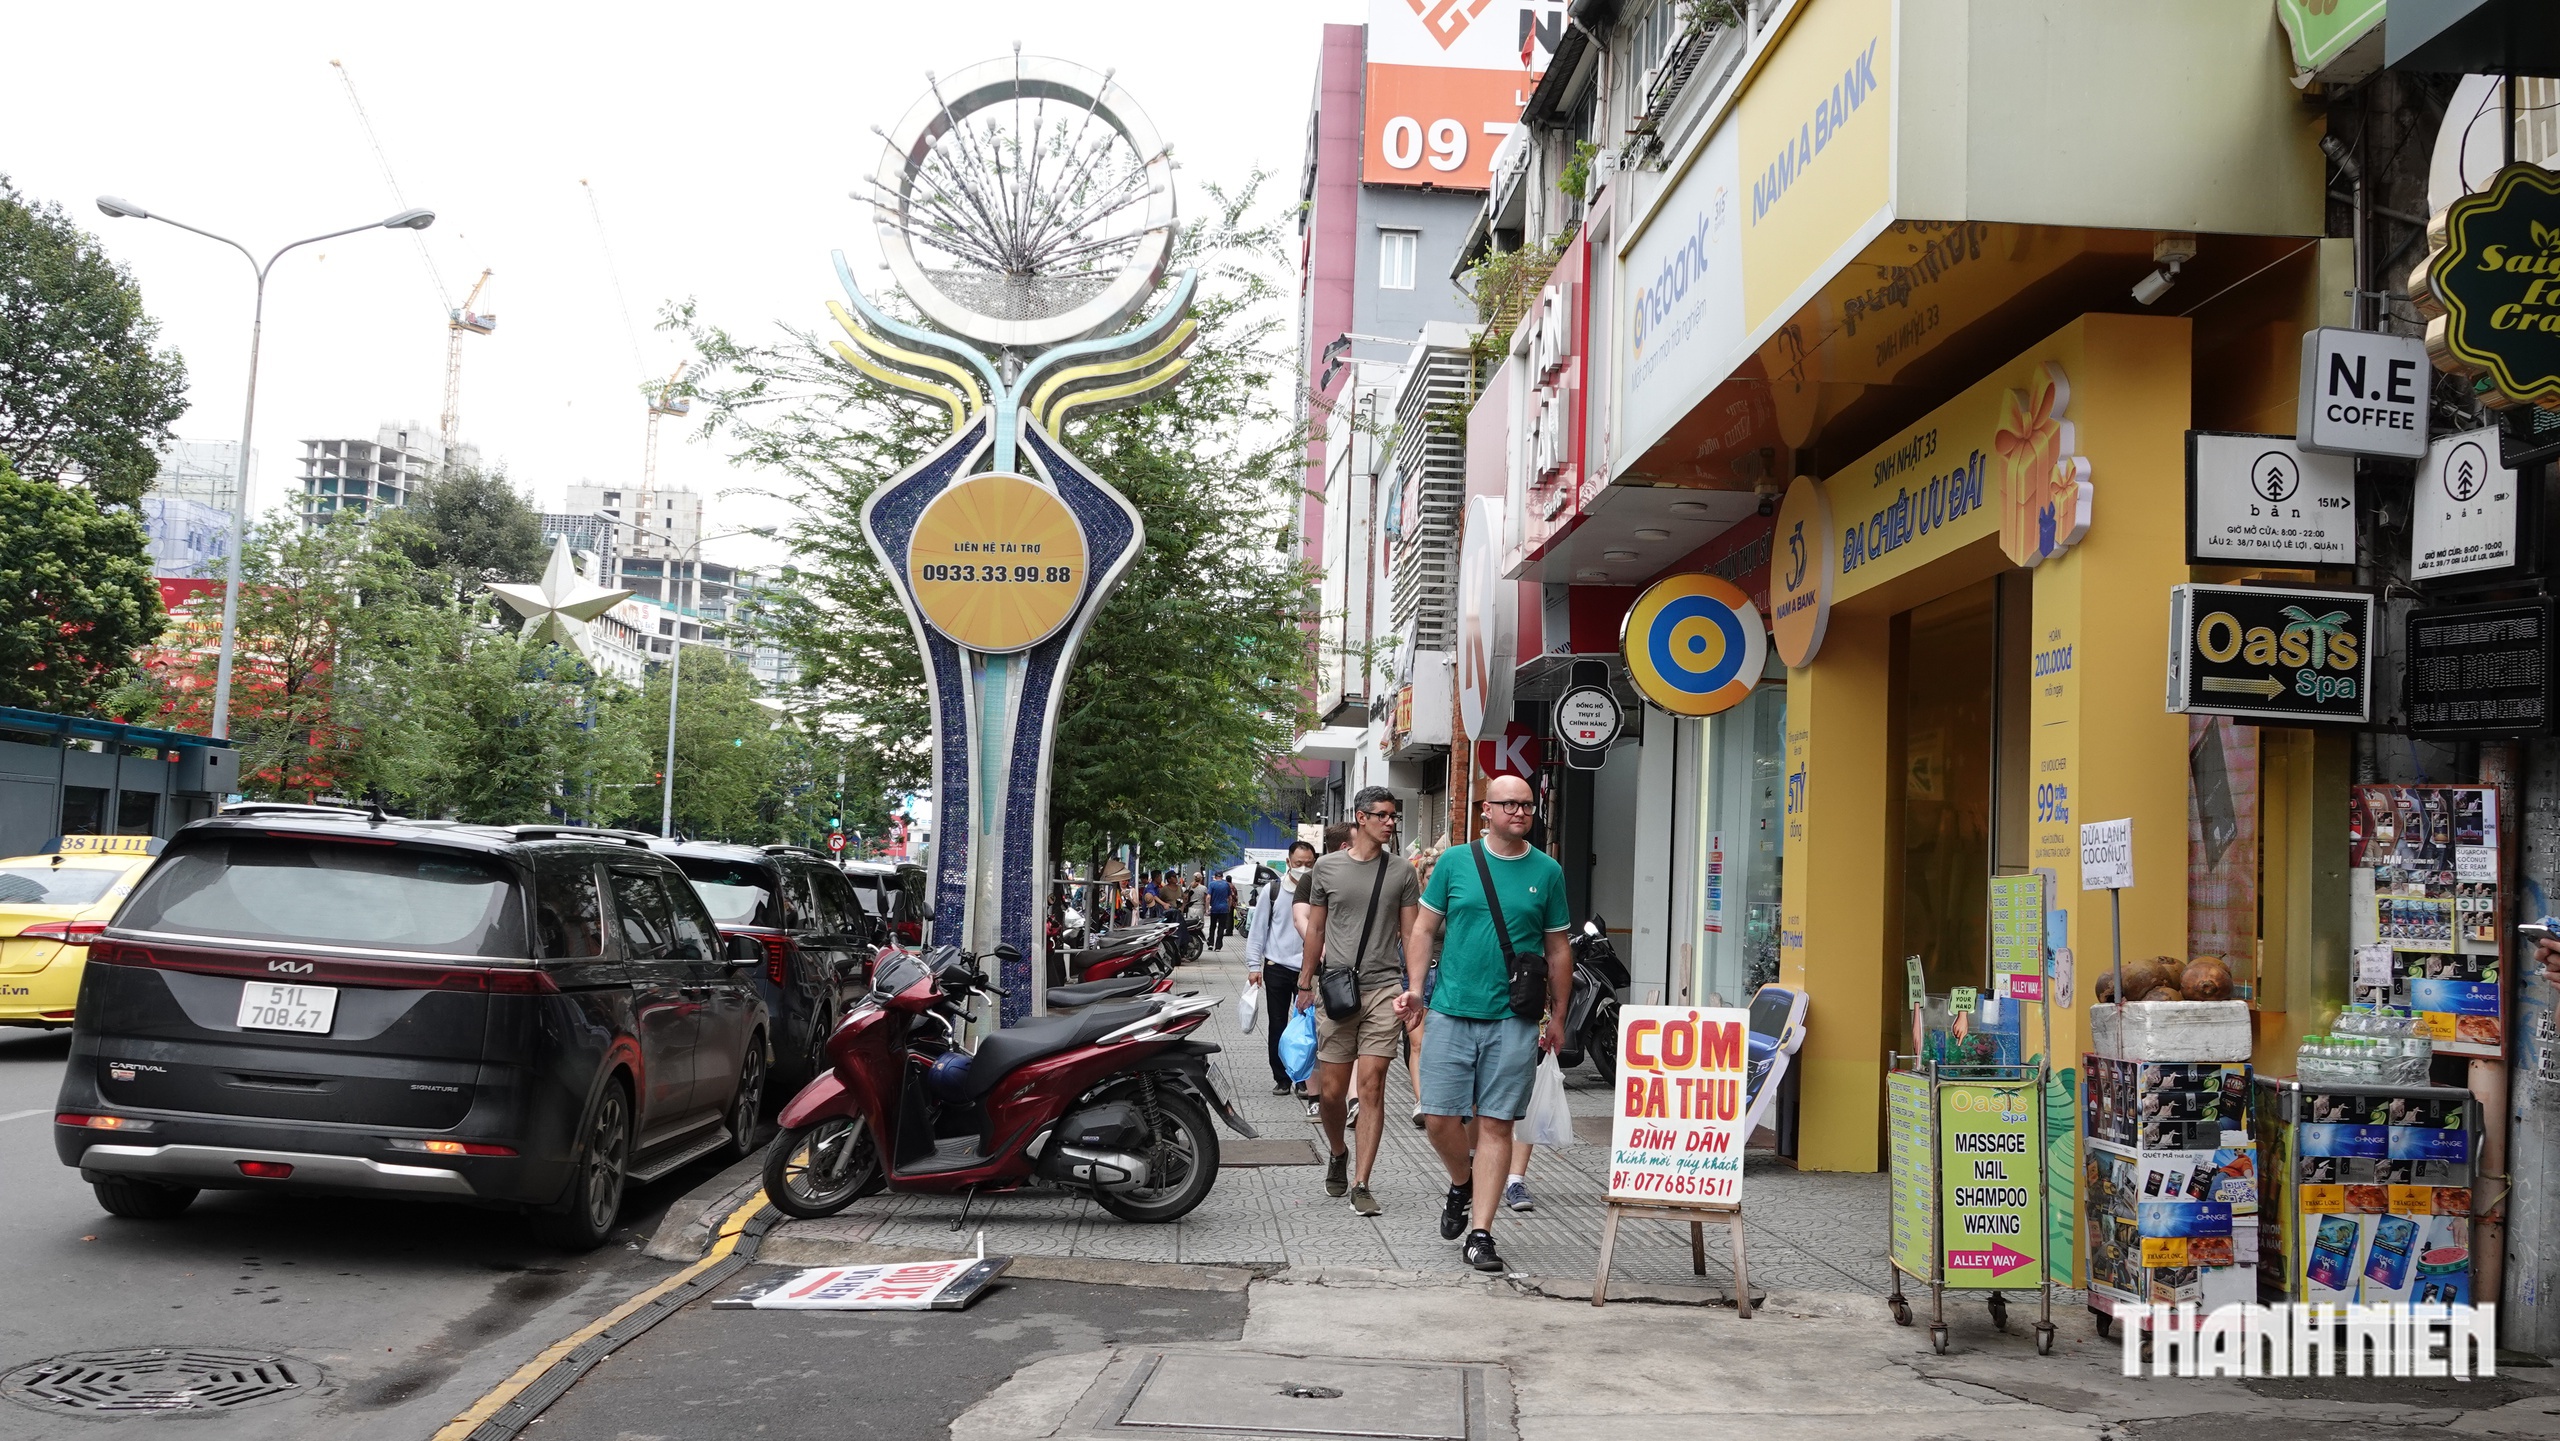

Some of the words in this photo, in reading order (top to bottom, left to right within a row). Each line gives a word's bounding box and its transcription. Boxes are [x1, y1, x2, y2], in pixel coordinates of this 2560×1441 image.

[1753, 137, 1795, 227] NAM
[1797, 121, 1812, 177] A
[1815, 35, 1878, 157] BANK
[2327, 404, 2414, 431] COFFEE
[1874, 455, 1895, 488] SINH
[1897, 434, 1924, 471] NHẬT
[1925, 428, 1937, 459] 33
[1843, 521, 1865, 574] ĐA
[1919, 474, 1948, 536] ƯU
[1949, 448, 1987, 522] ĐÃI
[2317, 497, 2339, 508] 15M
[2227, 524, 2242, 534] GIỜ
[2243, 524, 2257, 535] MỞ
[2259, 524, 2279, 536] CỬA:
[2281, 528, 2297, 537] 8:00
[2303, 528, 2325, 538] 22:00
[954, 541, 979, 552] LIÊN
[982, 541, 996, 555] HỆ
[1000, 541, 1017, 554] TÀI
[1020, 543, 1041, 556] TRỢ
[2209, 535, 2225, 546] LẦU
[2226, 538, 2233, 546] 2:
[2237, 538, 2254, 547] 38/7
[2256, 539, 2270, 549] ĐẠI
[2272, 538, 2283, 549] LỘ
[2284, 537, 2293, 549] LÊ
[2314, 540, 2337, 551] QUẬN
[2464, 546, 2479, 554] 8:00
[2485, 541, 2502, 551] 10:00
[922, 563, 1072, 584] 0933.33.99.88
[1776, 598, 1791, 621] NAM
[1791, 597, 1797, 614] A
[1797, 589, 1816, 610] BANK
[2295, 668, 2356, 704] Spa
[1494, 734, 1535, 779] K
[2037, 782, 2054, 824] 99
[61, 837, 86, 850] 38
[89, 838, 118, 850] 111
[2082, 844, 2127, 865] COCONUT
[2115, 862, 2128, 875] 20K
[270, 987, 308, 1007] 51L
[2011, 980, 2028, 994] ALLEY
[2027, 980, 2039, 994] WAY
[251, 1005, 322, 1028] 708.47
[1624, 1009, 1745, 1074] CƠM
[110, 1061, 168, 1073] CARNIVAL
[410, 1083, 459, 1093] SIGNATURE
[1624, 1067, 1670, 1119] BÀ
[1675, 1076, 1741, 1122] THU
[2001, 1110, 2027, 1124] Spa
[1629, 1122, 1677, 1151] BÌNH
[1954, 1132, 2026, 1153] MASSAGE
[1649, 1153, 1672, 1167] mời
[1701, 1152, 1740, 1173] khách
[1972, 1158, 2008, 1180] NAIL
[1612, 1171, 1631, 1191] ĐT:
[1633, 1171, 1734, 1197] 0776851511
[1954, 1186, 2028, 1208] SHAMPOO
[1963, 1213, 2021, 1235] WAXING
[1953, 1254, 1990, 1267] ALLEY
[1991, 1254, 2018, 1267] WAY
[2315, 1253, 2339, 1268] CAMEL
[2373, 1252, 2397, 1267] CAMEL
